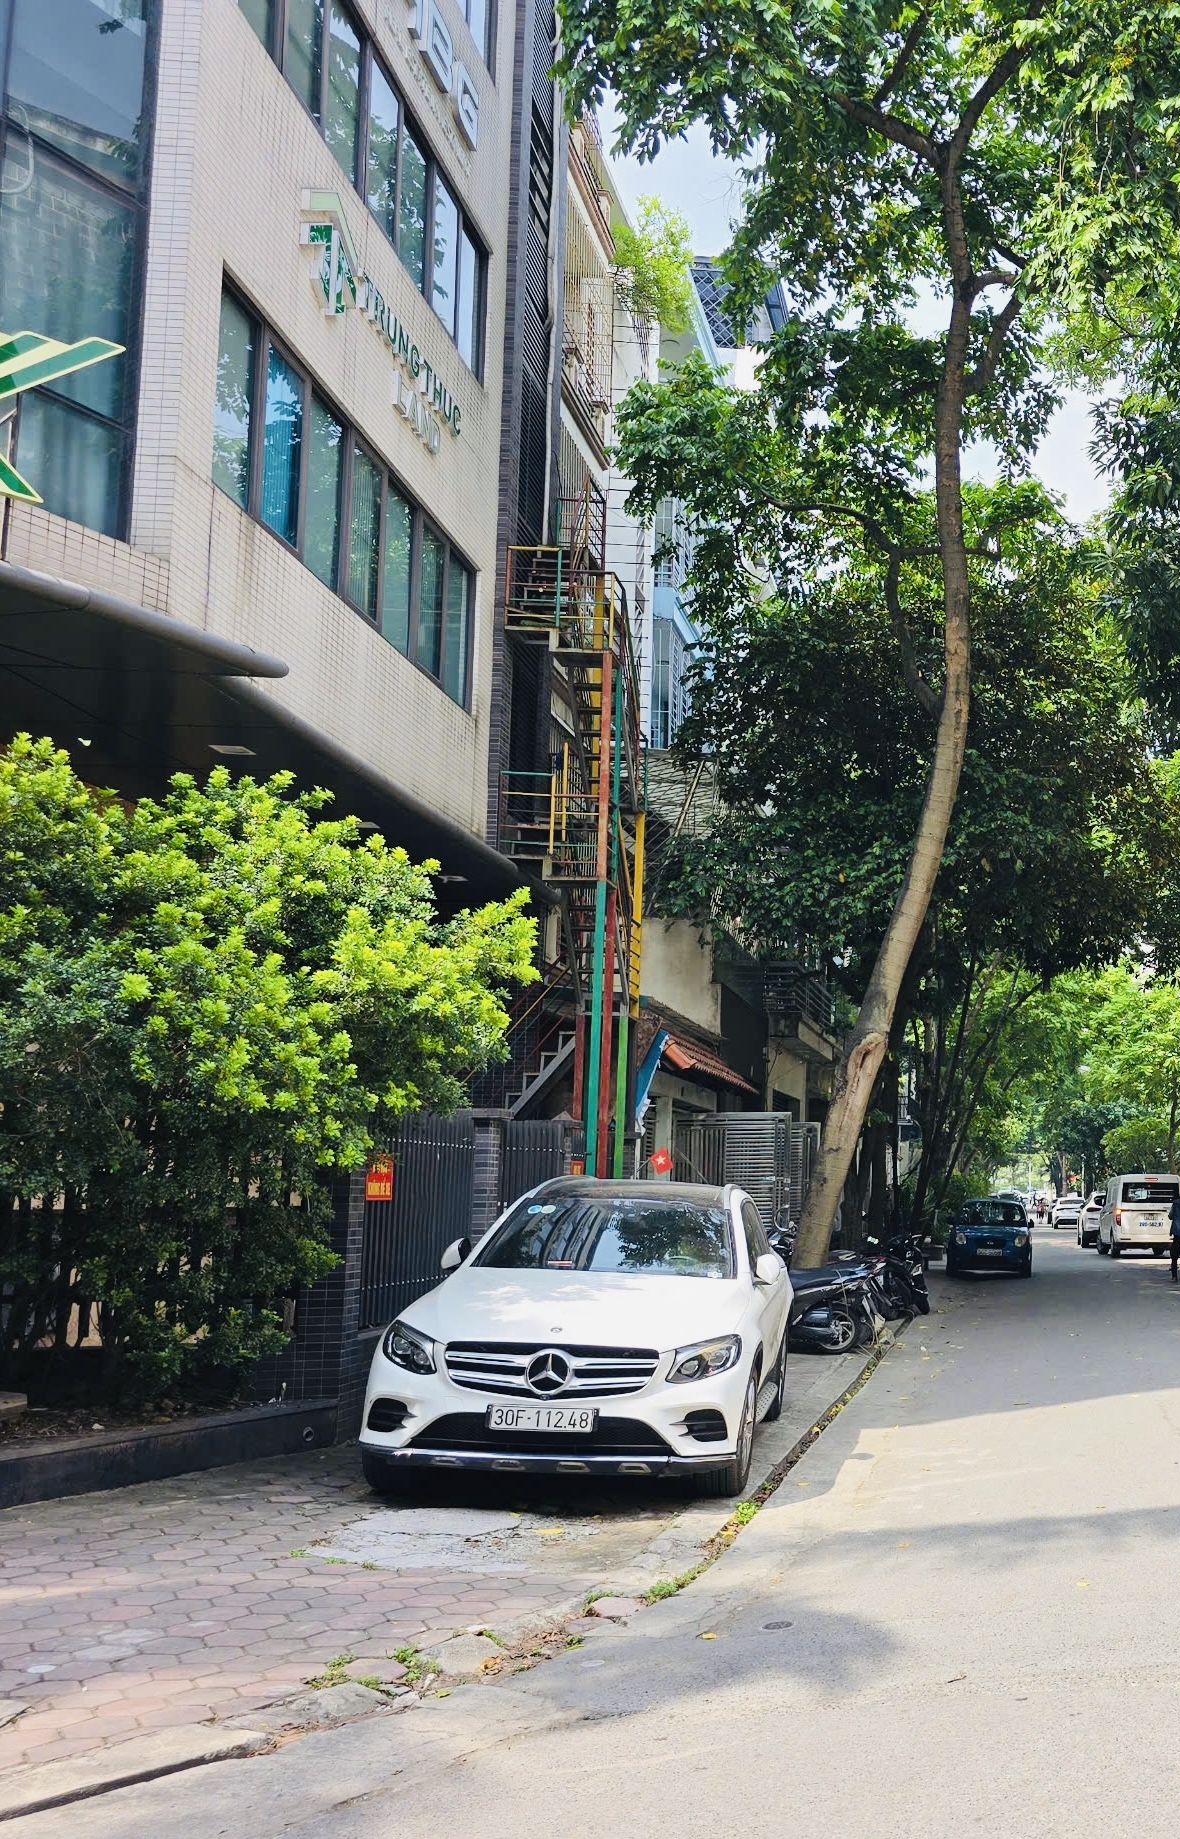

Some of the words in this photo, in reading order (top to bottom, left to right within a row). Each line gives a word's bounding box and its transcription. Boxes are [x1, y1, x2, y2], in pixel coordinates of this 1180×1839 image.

[405, 0, 478, 152] BG
[357, 268, 420, 378] TRUNG
[420, 354, 462, 437] THUC
[392, 369, 440, 455] LAND
[494, 1408, 590, 1429] 30F-112.48
